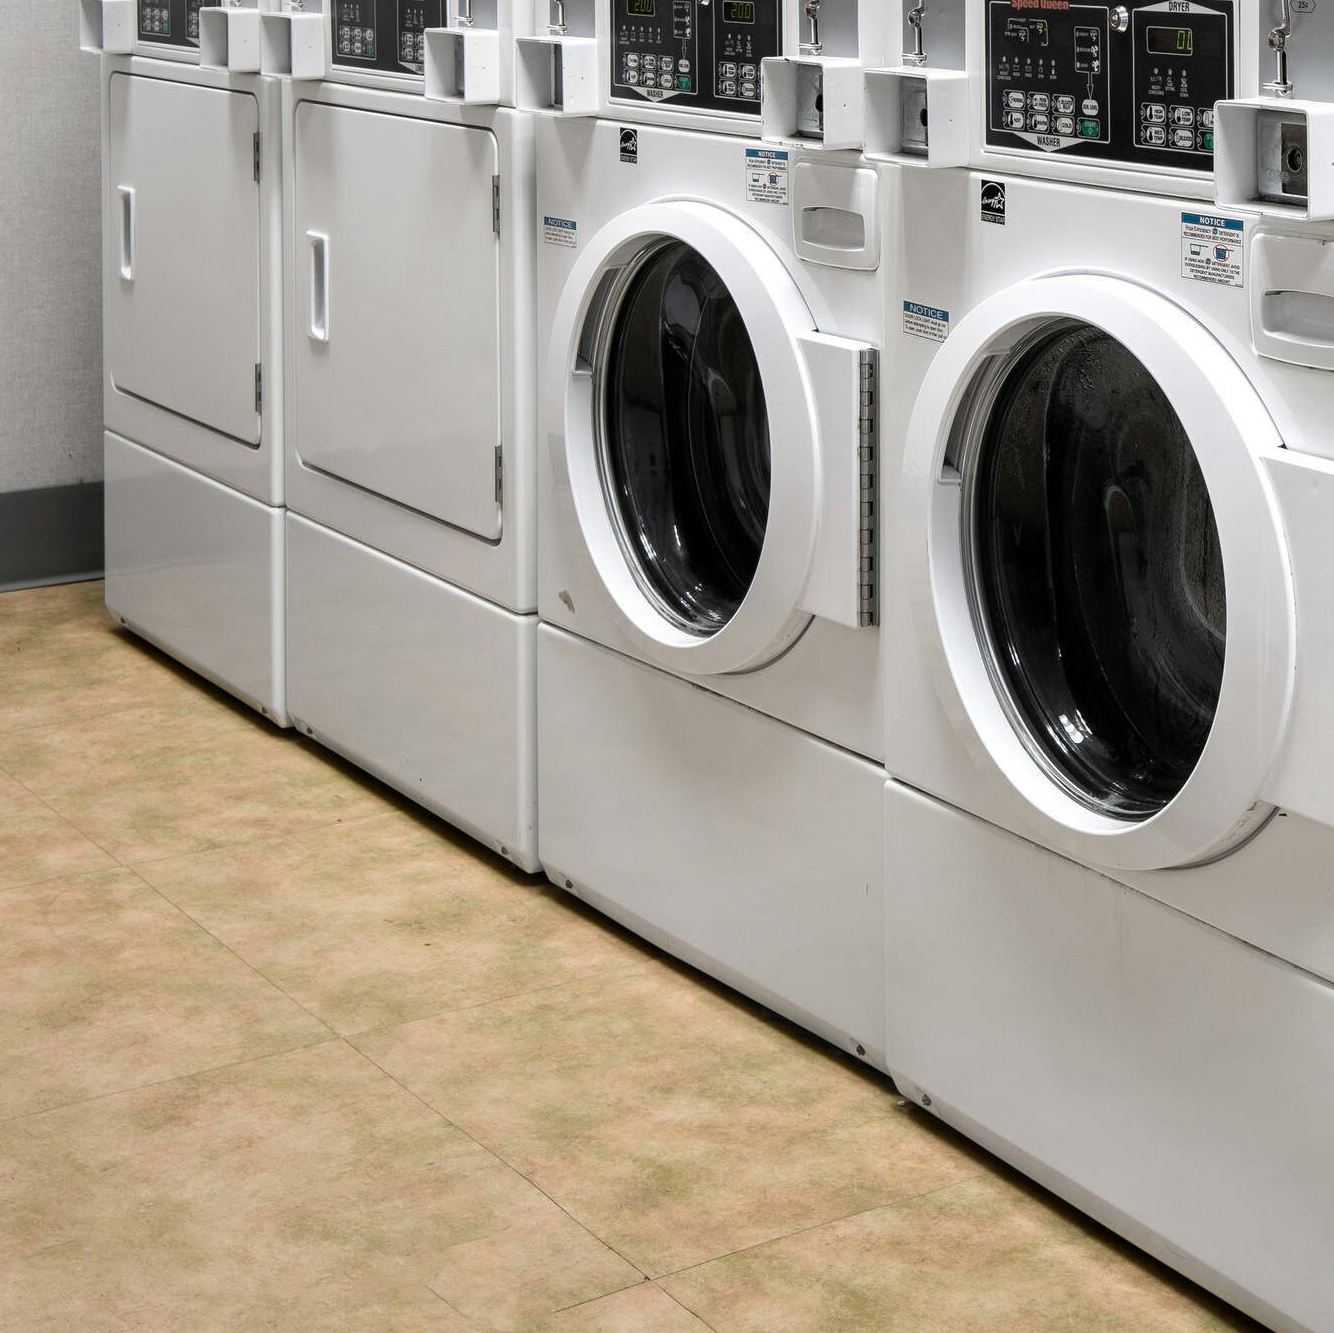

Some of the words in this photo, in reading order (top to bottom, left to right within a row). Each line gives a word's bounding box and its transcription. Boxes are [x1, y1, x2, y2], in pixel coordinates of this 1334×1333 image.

[731, 2, 751, 18] 200
[1168, 2, 1189, 12] DRYER
[1037, 136, 1060, 147] WASHER
[548, 218, 572, 229] NOTICE
[1200, 217, 1225, 226] NOTICE
[910, 304, 942, 319] NOTICE
